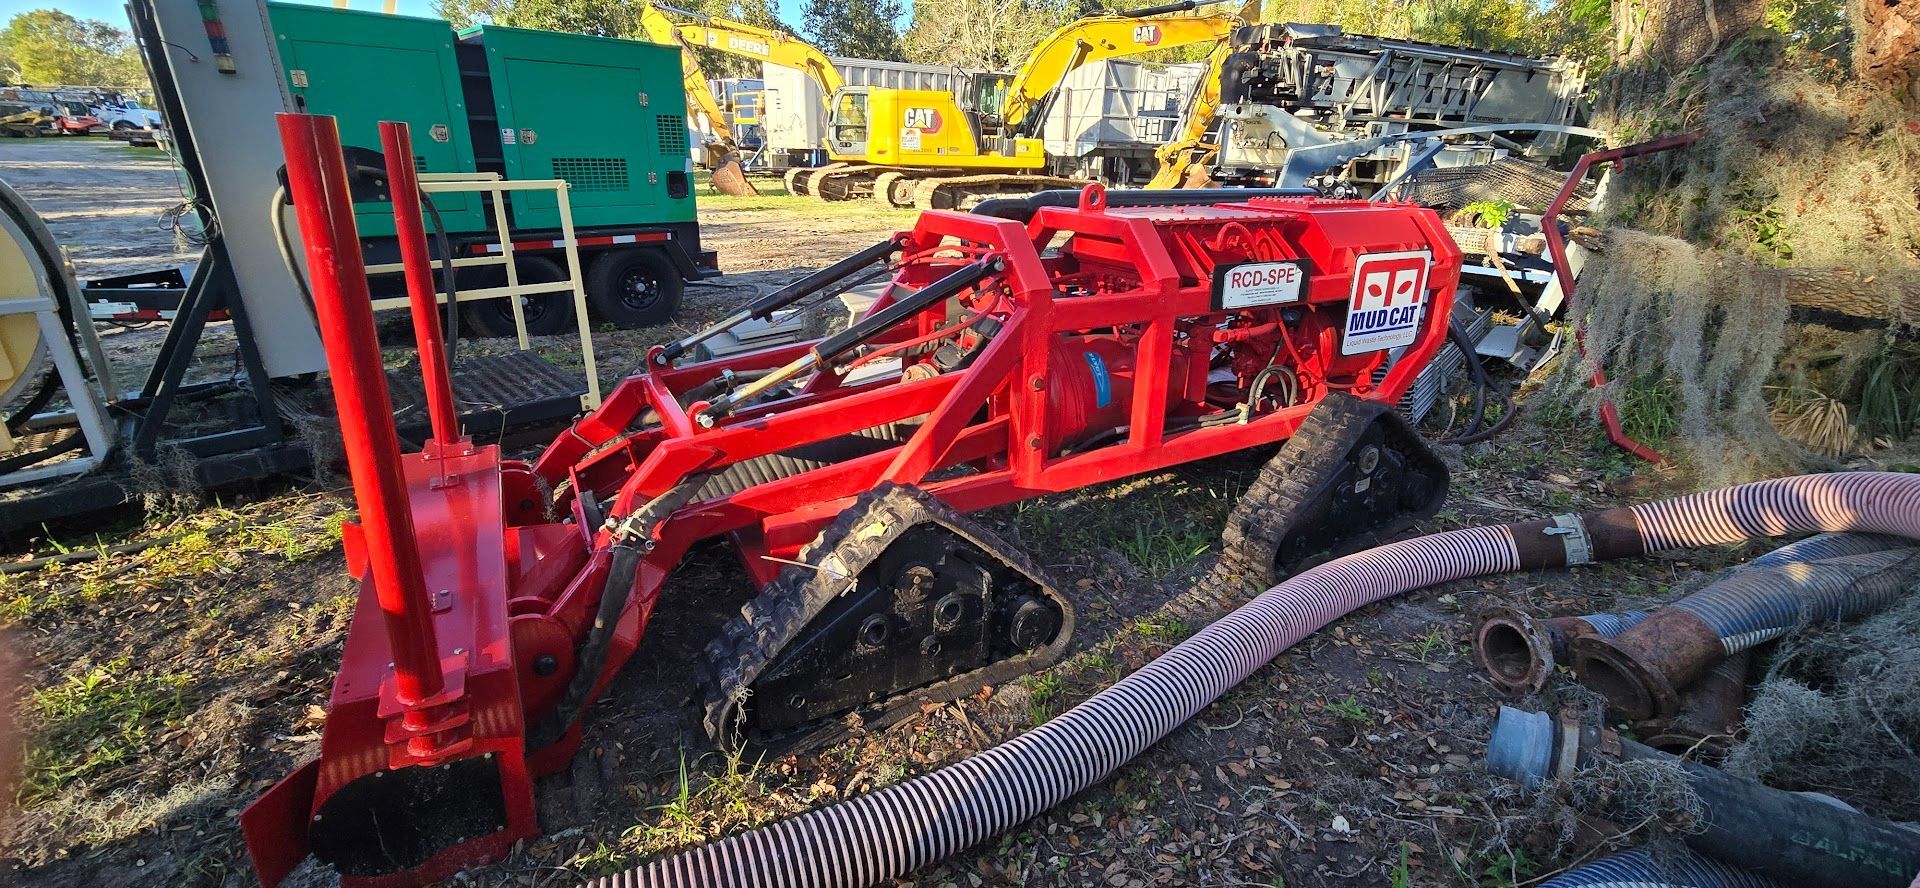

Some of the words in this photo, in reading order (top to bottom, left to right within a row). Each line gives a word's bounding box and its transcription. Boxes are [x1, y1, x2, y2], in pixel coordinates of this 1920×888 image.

[1134, 25, 1155, 42] CAT
[728, 37, 770, 56] DEERE
[904, 108, 934, 129] CAT
[1231, 267, 1295, 289] RCD-SPE
[1349, 309, 1388, 332] MUD
[1389, 305, 1418, 326] CAT
[1346, 339, 1361, 347] Liquid
